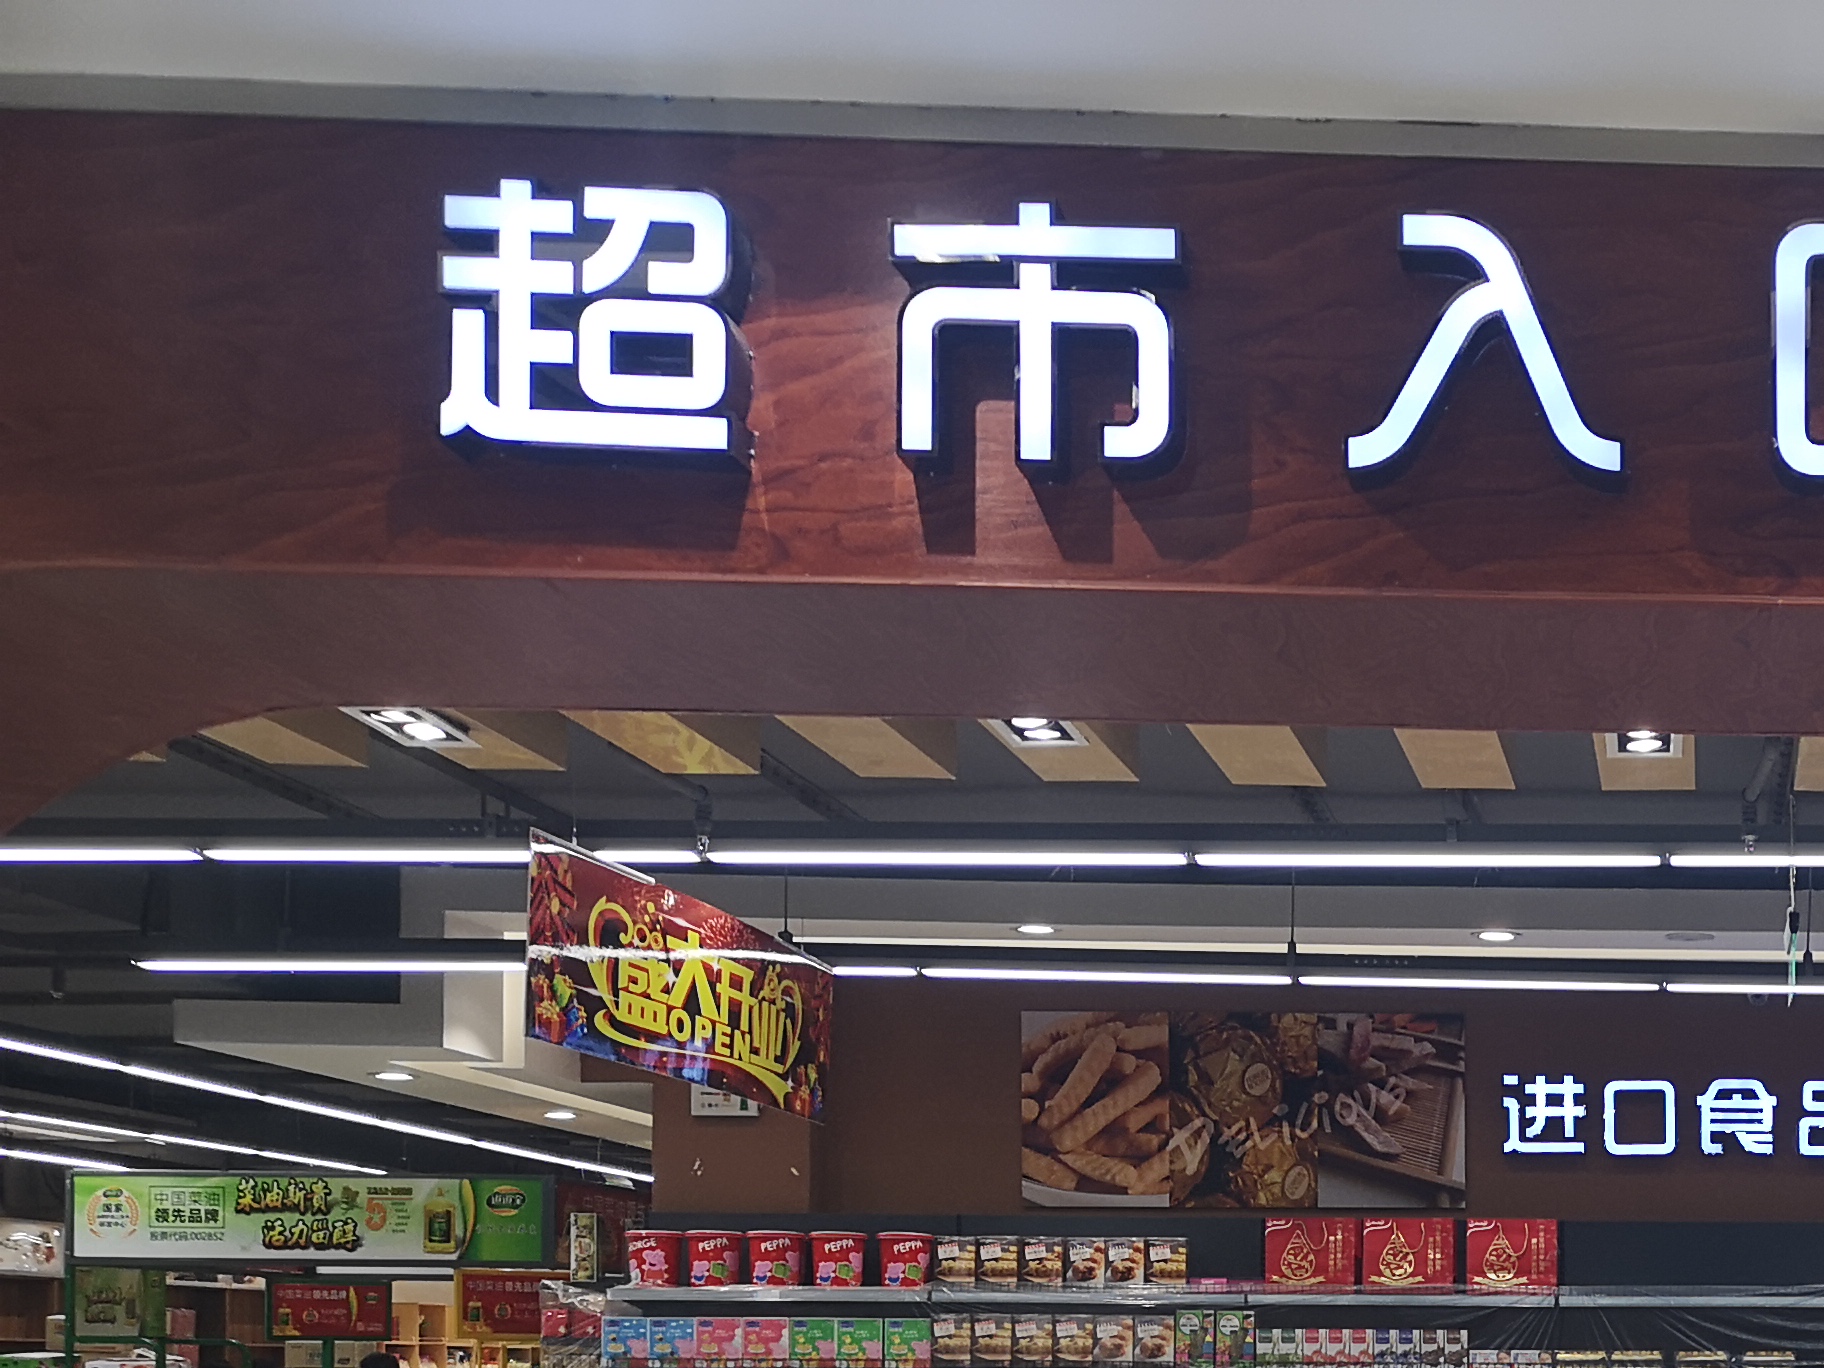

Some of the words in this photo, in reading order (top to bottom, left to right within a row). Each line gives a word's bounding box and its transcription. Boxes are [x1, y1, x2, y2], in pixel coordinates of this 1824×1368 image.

[668, 1008, 751, 1063] OPEN
[154, 1191, 220, 1206] 中国菜油
[154, 1208, 220, 1224] 领先品牌
[698, 1237, 729, 1252] PEPPA
[760, 1237, 791, 1252] PEPPA
[824, 1239, 854, 1253] PEPPA
[893, 1239, 923, 1254] PEPPA
